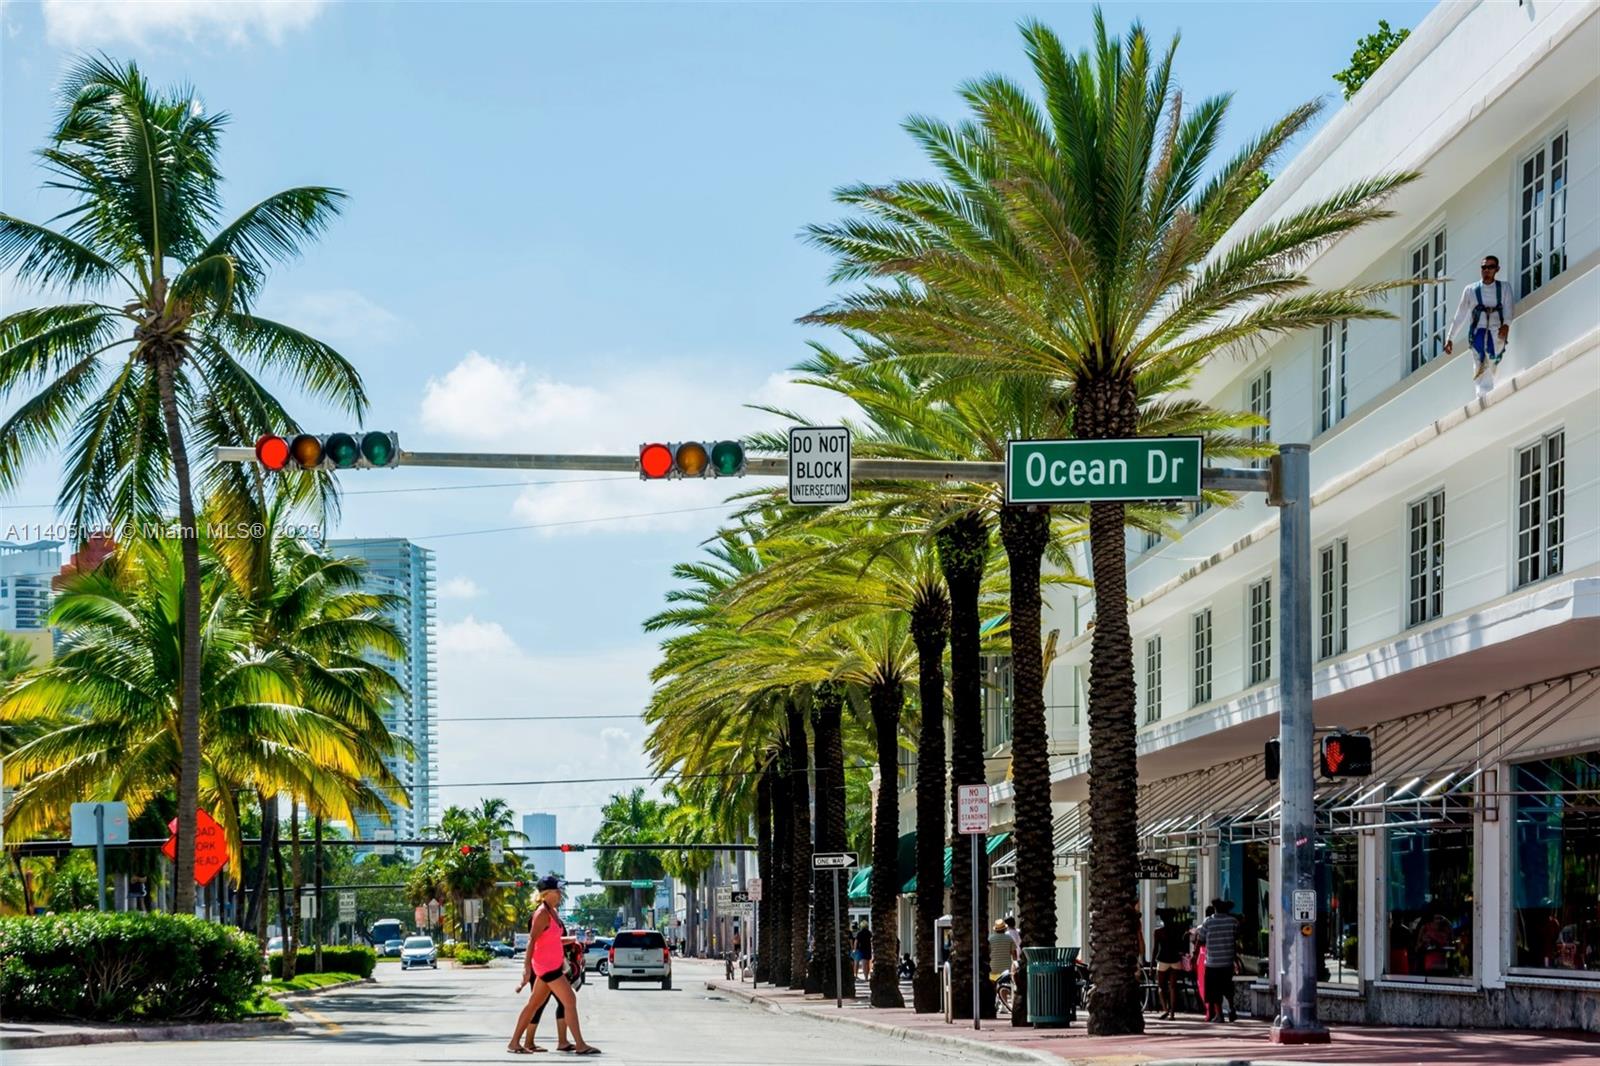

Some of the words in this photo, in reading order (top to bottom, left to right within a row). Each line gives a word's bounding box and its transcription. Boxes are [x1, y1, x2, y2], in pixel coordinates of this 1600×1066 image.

[793, 436, 812, 453] DO
[819, 435, 846, 453] NOT
[796, 461, 843, 478] BLOCK
[1026, 451, 1128, 486] Ocean
[1147, 449, 1184, 483] Dr
[793, 484, 847, 496] INTERSECTION
[969, 788, 979, 796] NO
